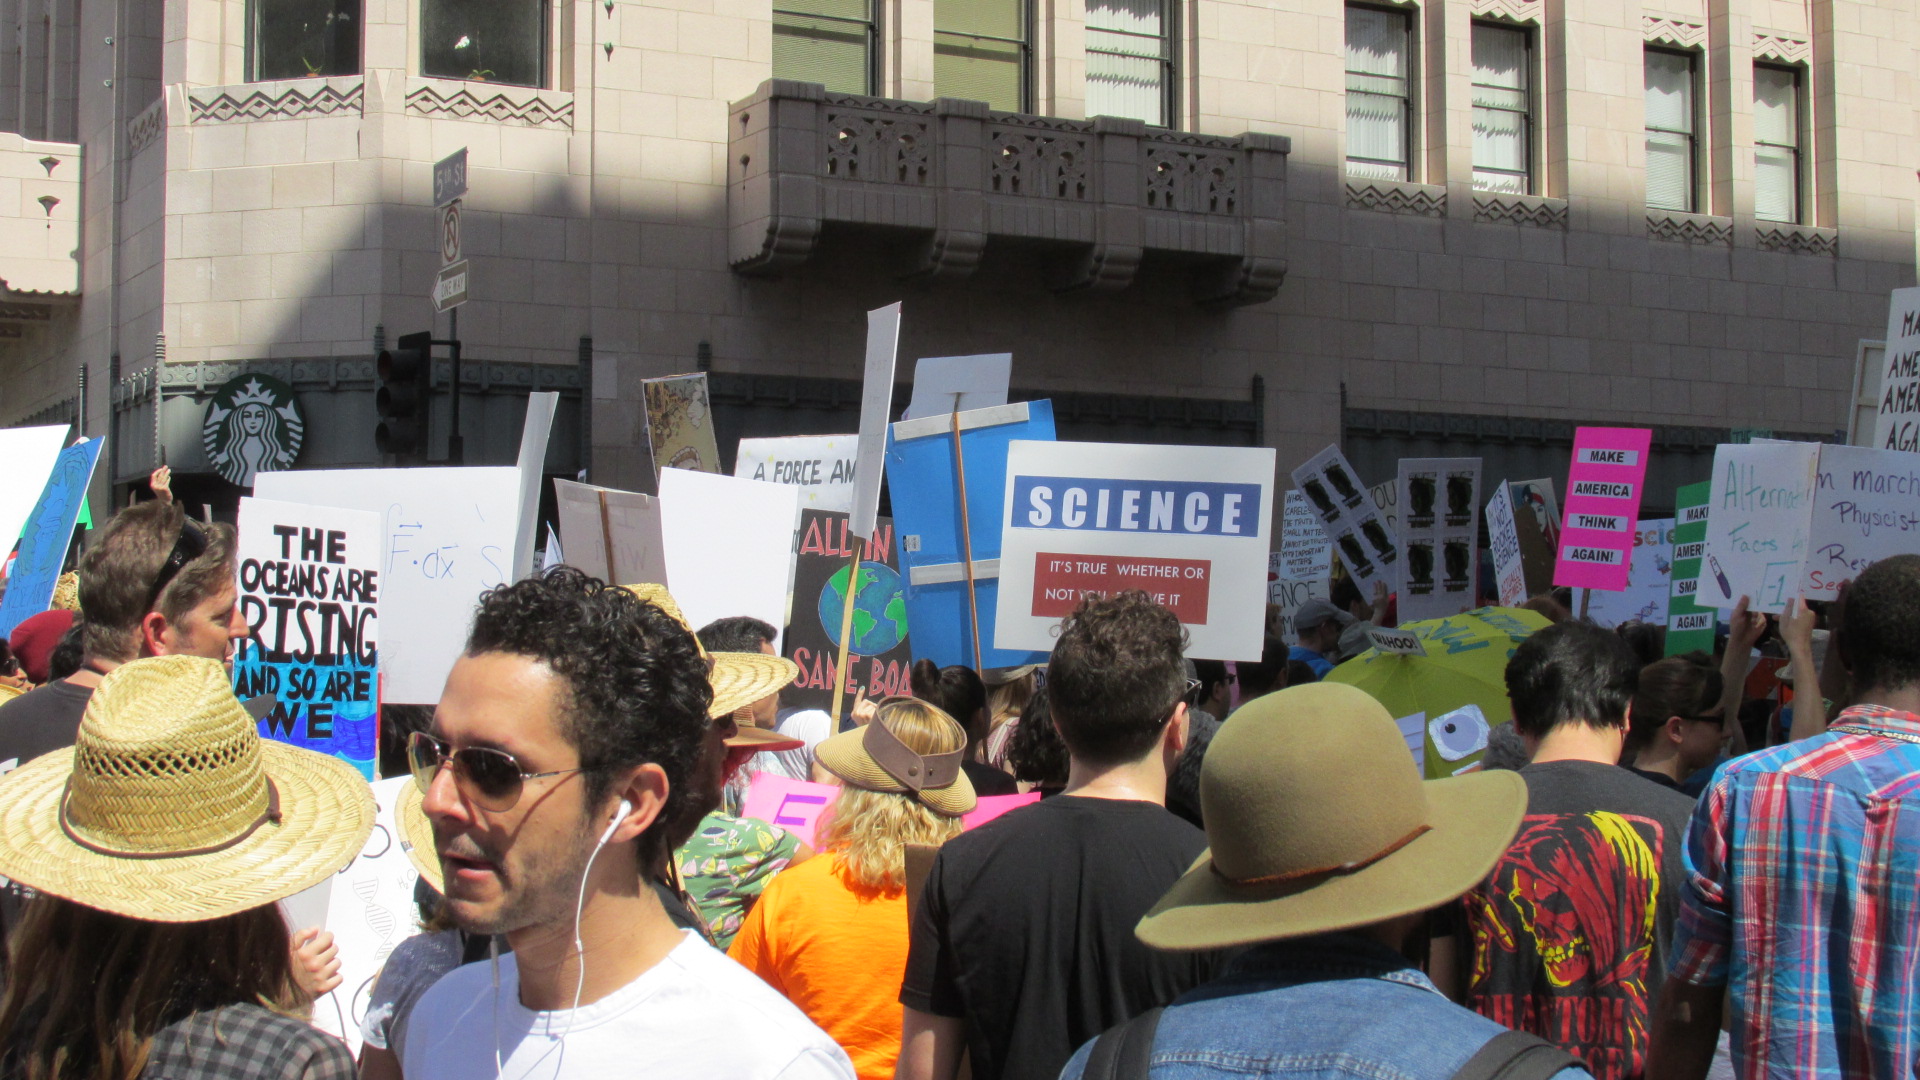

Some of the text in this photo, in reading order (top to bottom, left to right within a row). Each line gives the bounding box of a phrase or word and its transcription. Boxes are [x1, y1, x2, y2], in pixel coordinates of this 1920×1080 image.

[436, 161, 464, 199] 5th St
[441, 274, 464, 298] ONE WAY
[753, 462, 766, 481] A
[773, 459, 822, 485] FORCE
[1590, 450, 1624, 463] MAKE
[1370, 480, 1397, 510] OU
[1574, 482, 1629, 497] AMERICA
[1028, 485, 1243, 534] SCIENCE
[1496, 503, 1508, 529] NOT
[1578, 515, 1617, 529] THINK
[1830, 501, 1920, 537] Physicist
[273, 524, 347, 565] THE
[800, 517, 852, 557] ALL
[863, 524, 892, 564] IN
[1493, 518, 1514, 555] ROCKET
[1728, 521, 1778, 553] Facts
[1050, 560, 1205, 580] IT'S TRUE WHETHER OR
[1495, 535, 1519, 575] SCIENCE
[1571, 548, 1614, 562] AGAIN!
[240, 557, 378, 604] OCEANS ARE
[1045, 588, 1075, 601] NOT
[1169, 593, 1181, 606] IT
[238, 594, 378, 668] RISING
[1676, 615, 1708, 629] AGAIN!
[1371, 632, 1418, 649] WAHOO!
[234, 664, 371, 702] AND SO ARE
[265, 702, 333, 739] WE
